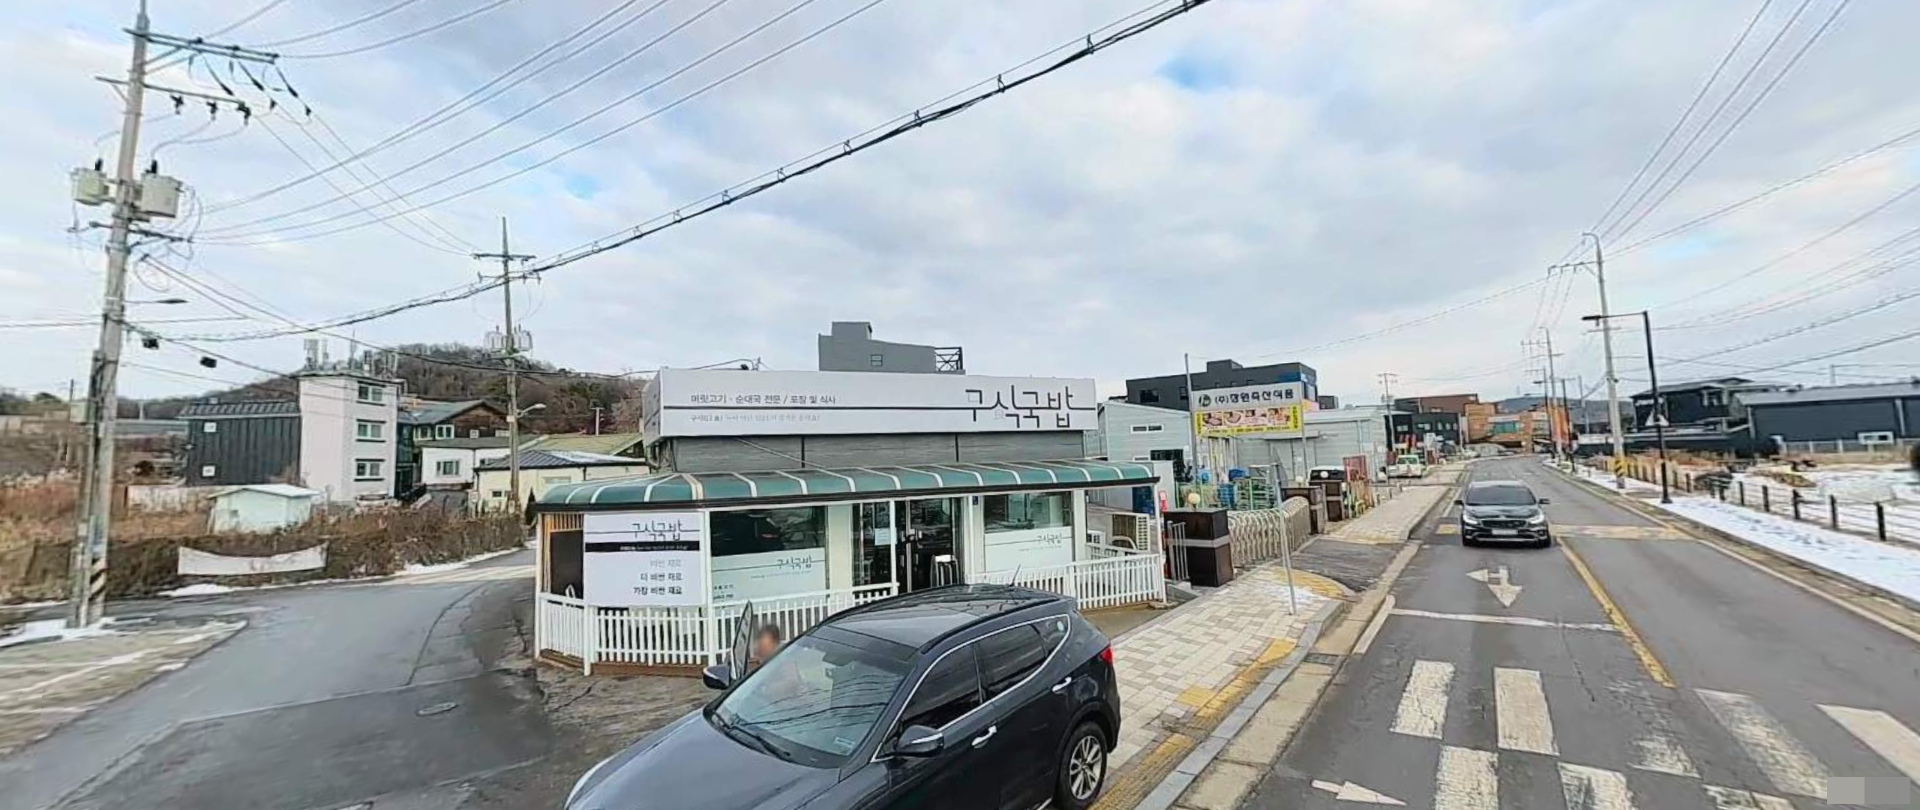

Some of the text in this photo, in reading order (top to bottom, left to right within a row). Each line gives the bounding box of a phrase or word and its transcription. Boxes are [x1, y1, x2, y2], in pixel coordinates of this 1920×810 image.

[735, 394, 761, 404] 순대국
[763, 394, 781, 404] 전문
[790, 395, 807, 404] 포장
[809, 395, 818, 404] 및
[820, 394, 836, 404] 식사
[965, 384, 1094, 429] 구식국밥
[632, 519, 699, 542] 구식국밥
[777, 555, 813, 570] 구식국밥
